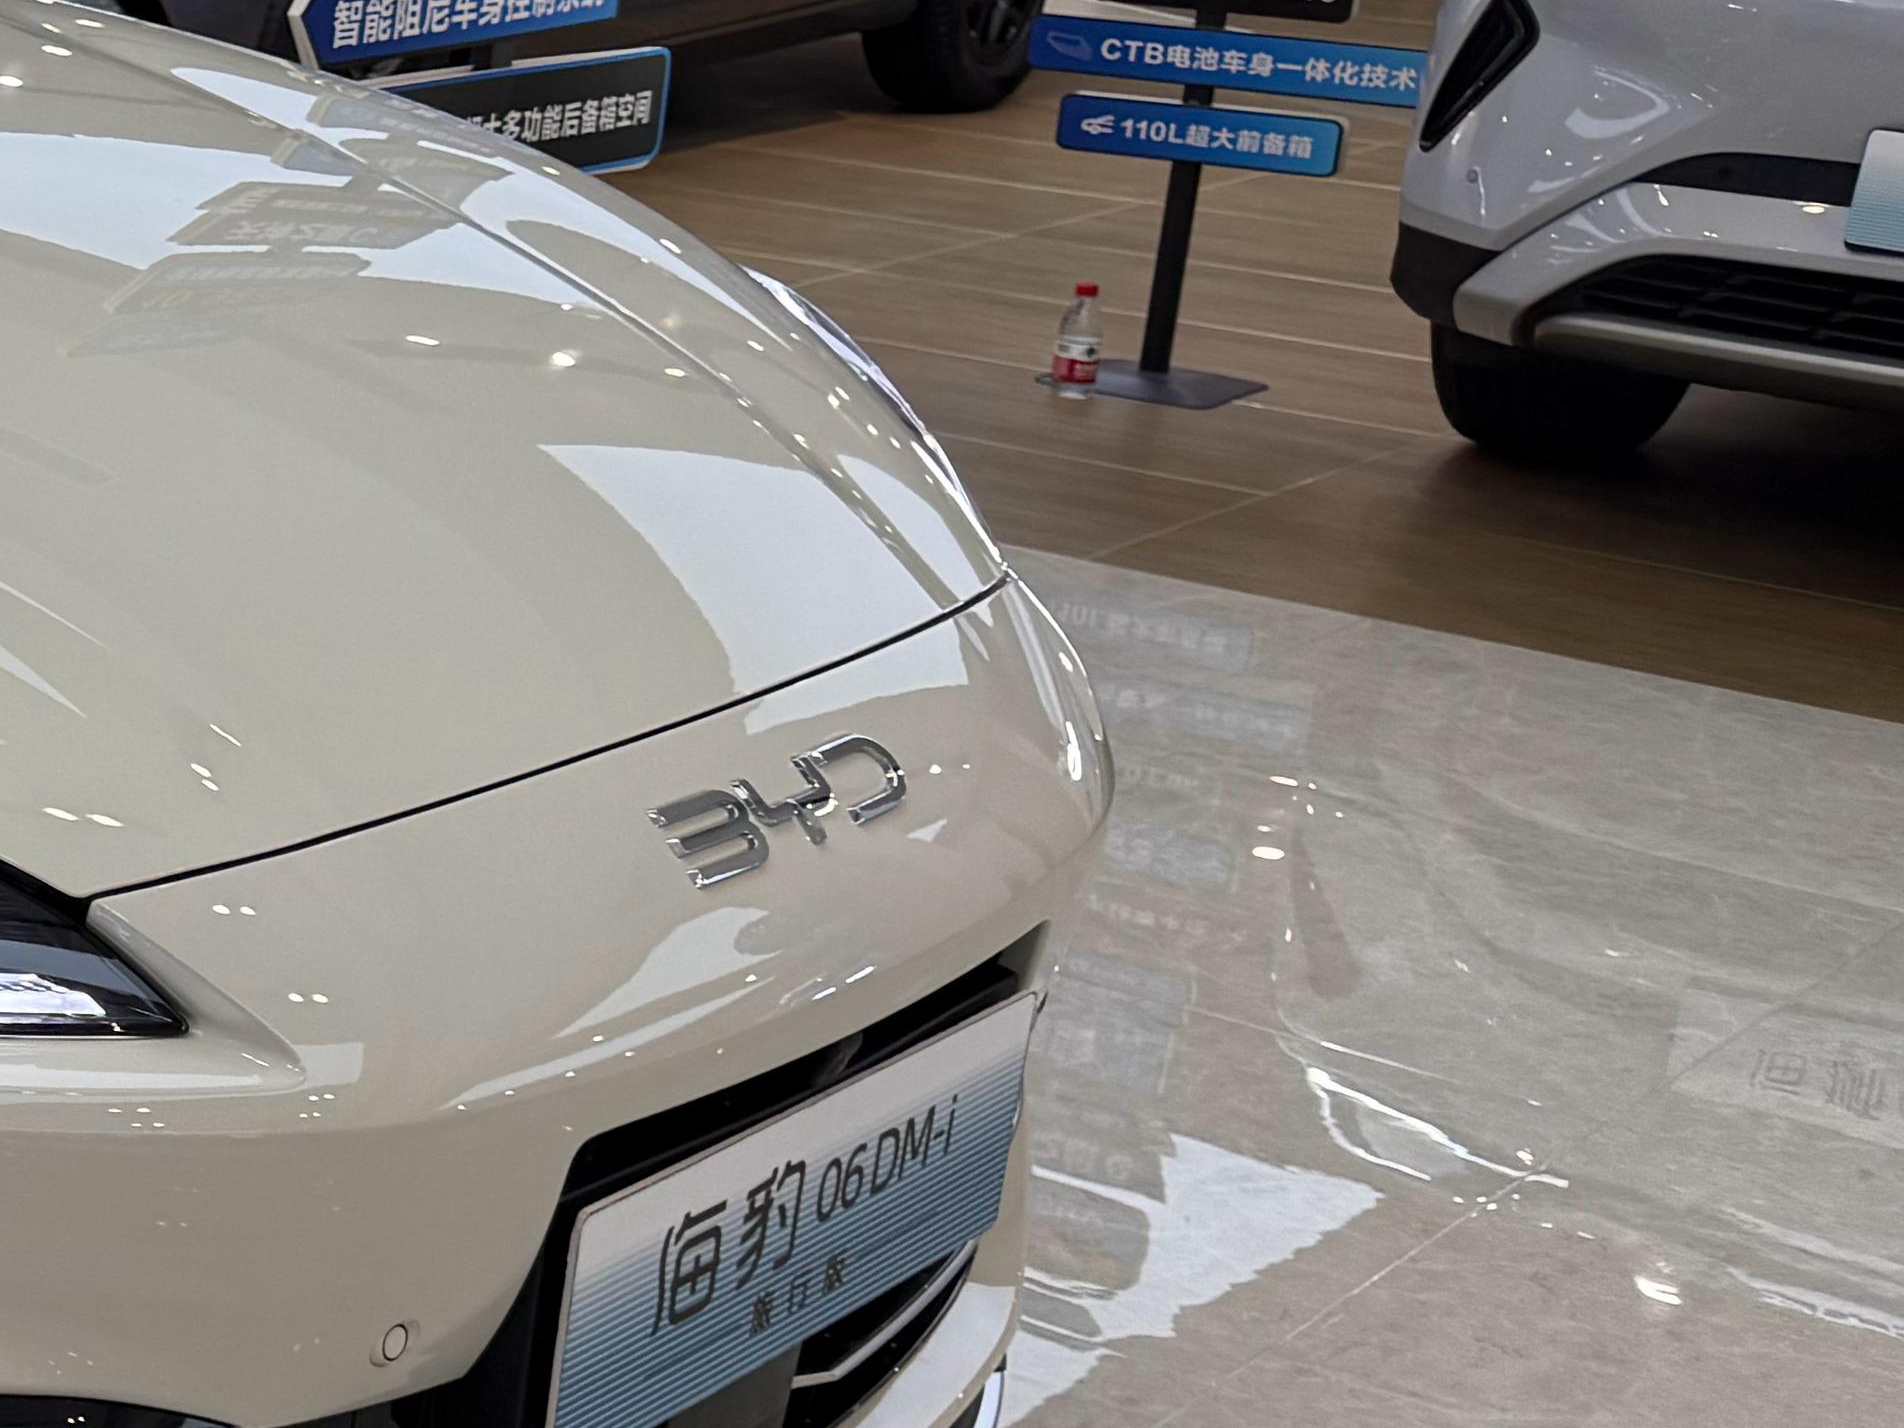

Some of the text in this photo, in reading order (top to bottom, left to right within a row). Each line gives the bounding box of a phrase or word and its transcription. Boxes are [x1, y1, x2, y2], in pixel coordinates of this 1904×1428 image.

[1099, 37, 1418, 91] CTB电池车身一体化技术
[1120, 119, 1314, 160] 110L超大前备箱
[646, 732, 908, 890] BYD
